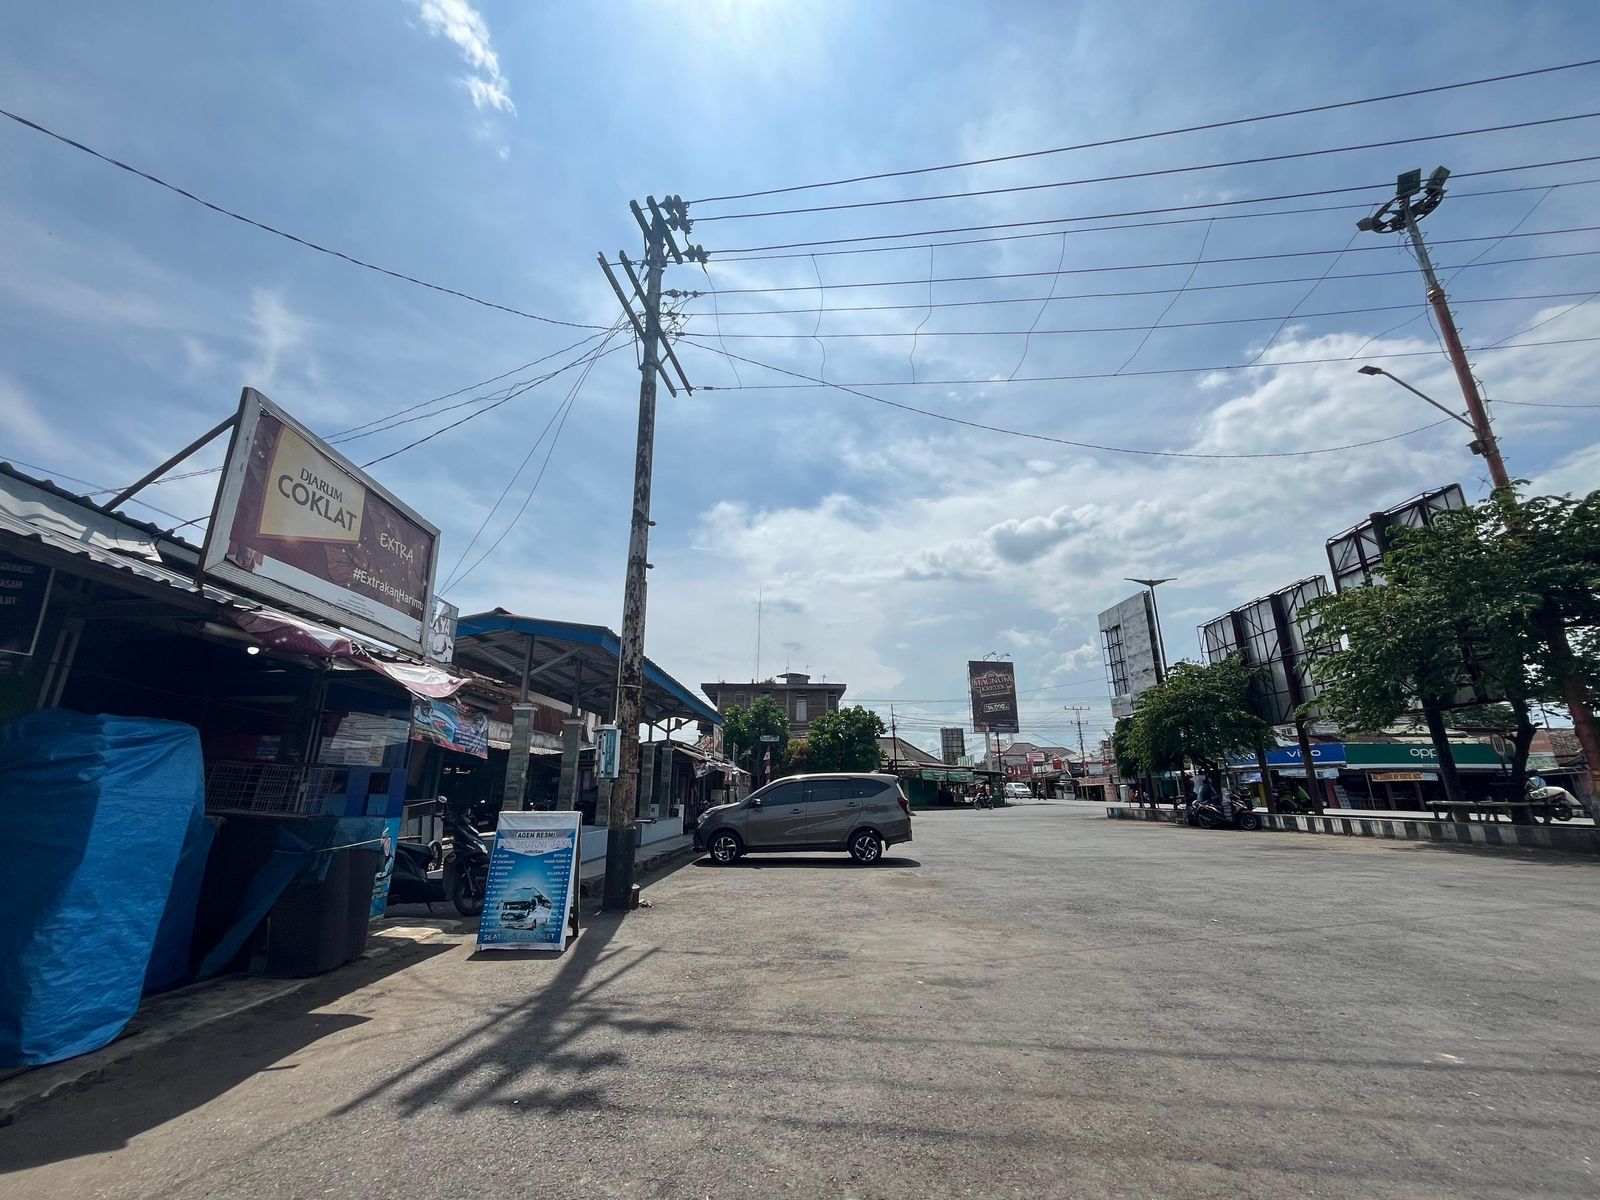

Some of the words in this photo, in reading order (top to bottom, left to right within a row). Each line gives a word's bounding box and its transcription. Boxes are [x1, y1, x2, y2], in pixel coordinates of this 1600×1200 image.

[300, 467, 343, 504] DJARUM
[277, 474, 358, 533] COKLAT
[379, 532, 414, 565] EXTRA
[973, 675, 1013, 687] MAGNUM
[1286, 748, 1322, 758] vio
[1409, 747, 1438, 759] opp
